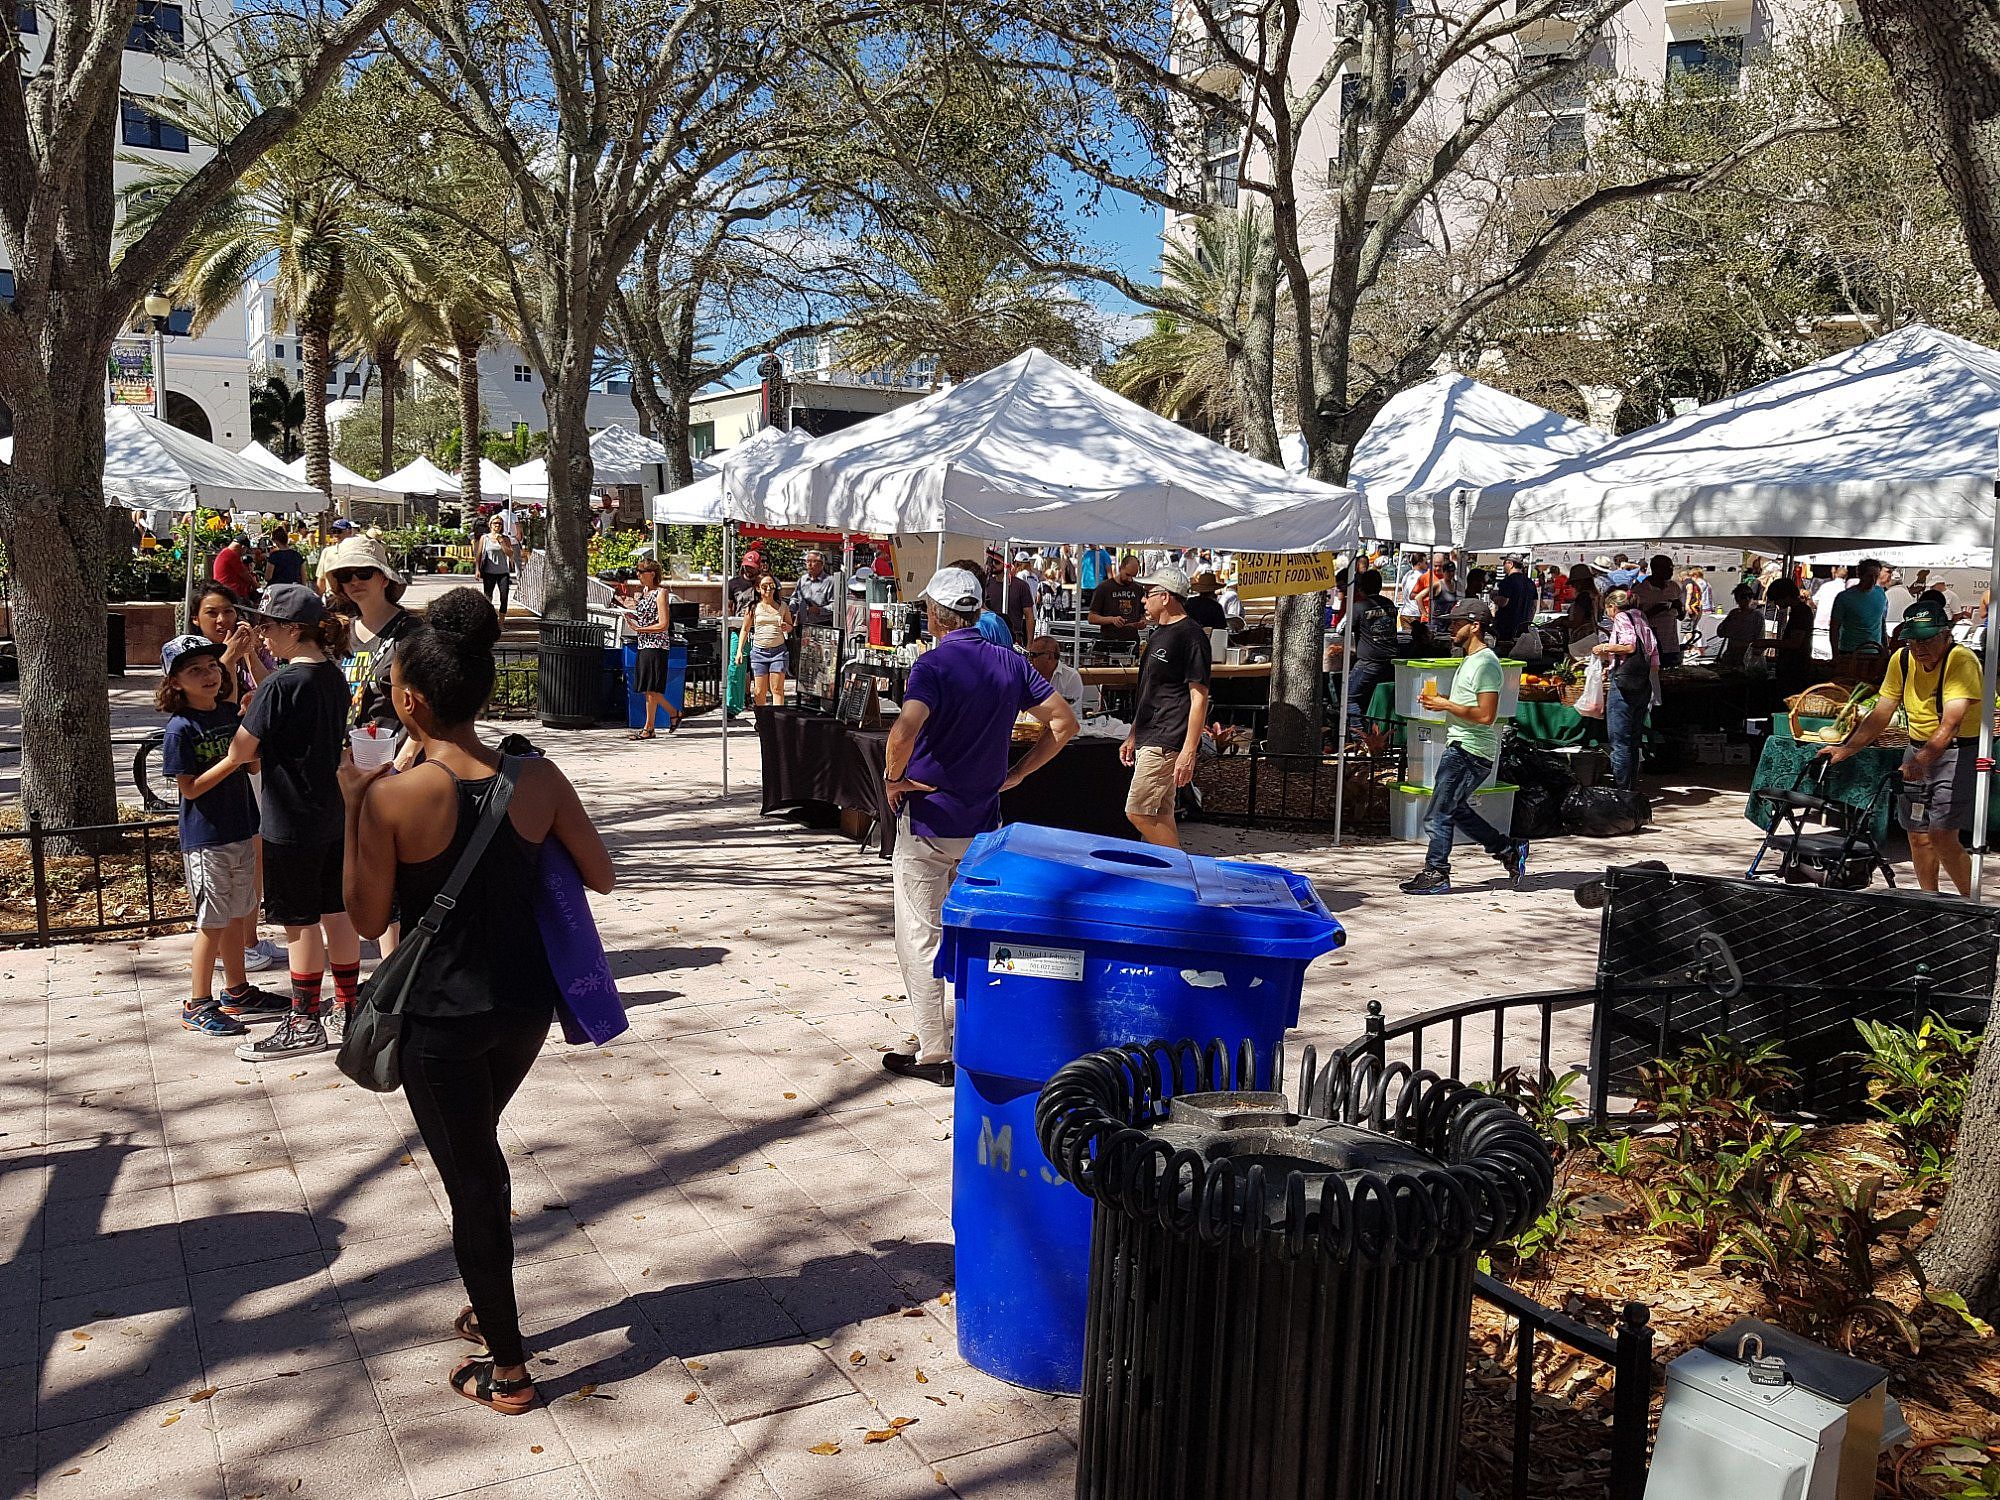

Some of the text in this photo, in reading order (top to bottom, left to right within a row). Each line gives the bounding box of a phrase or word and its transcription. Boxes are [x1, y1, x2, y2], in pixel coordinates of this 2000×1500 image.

[1240, 552, 1282, 569] PASTA
[1239, 566, 1330, 586] GOURMET FOOD INC
[1112, 590, 1136, 599] BARÇA
